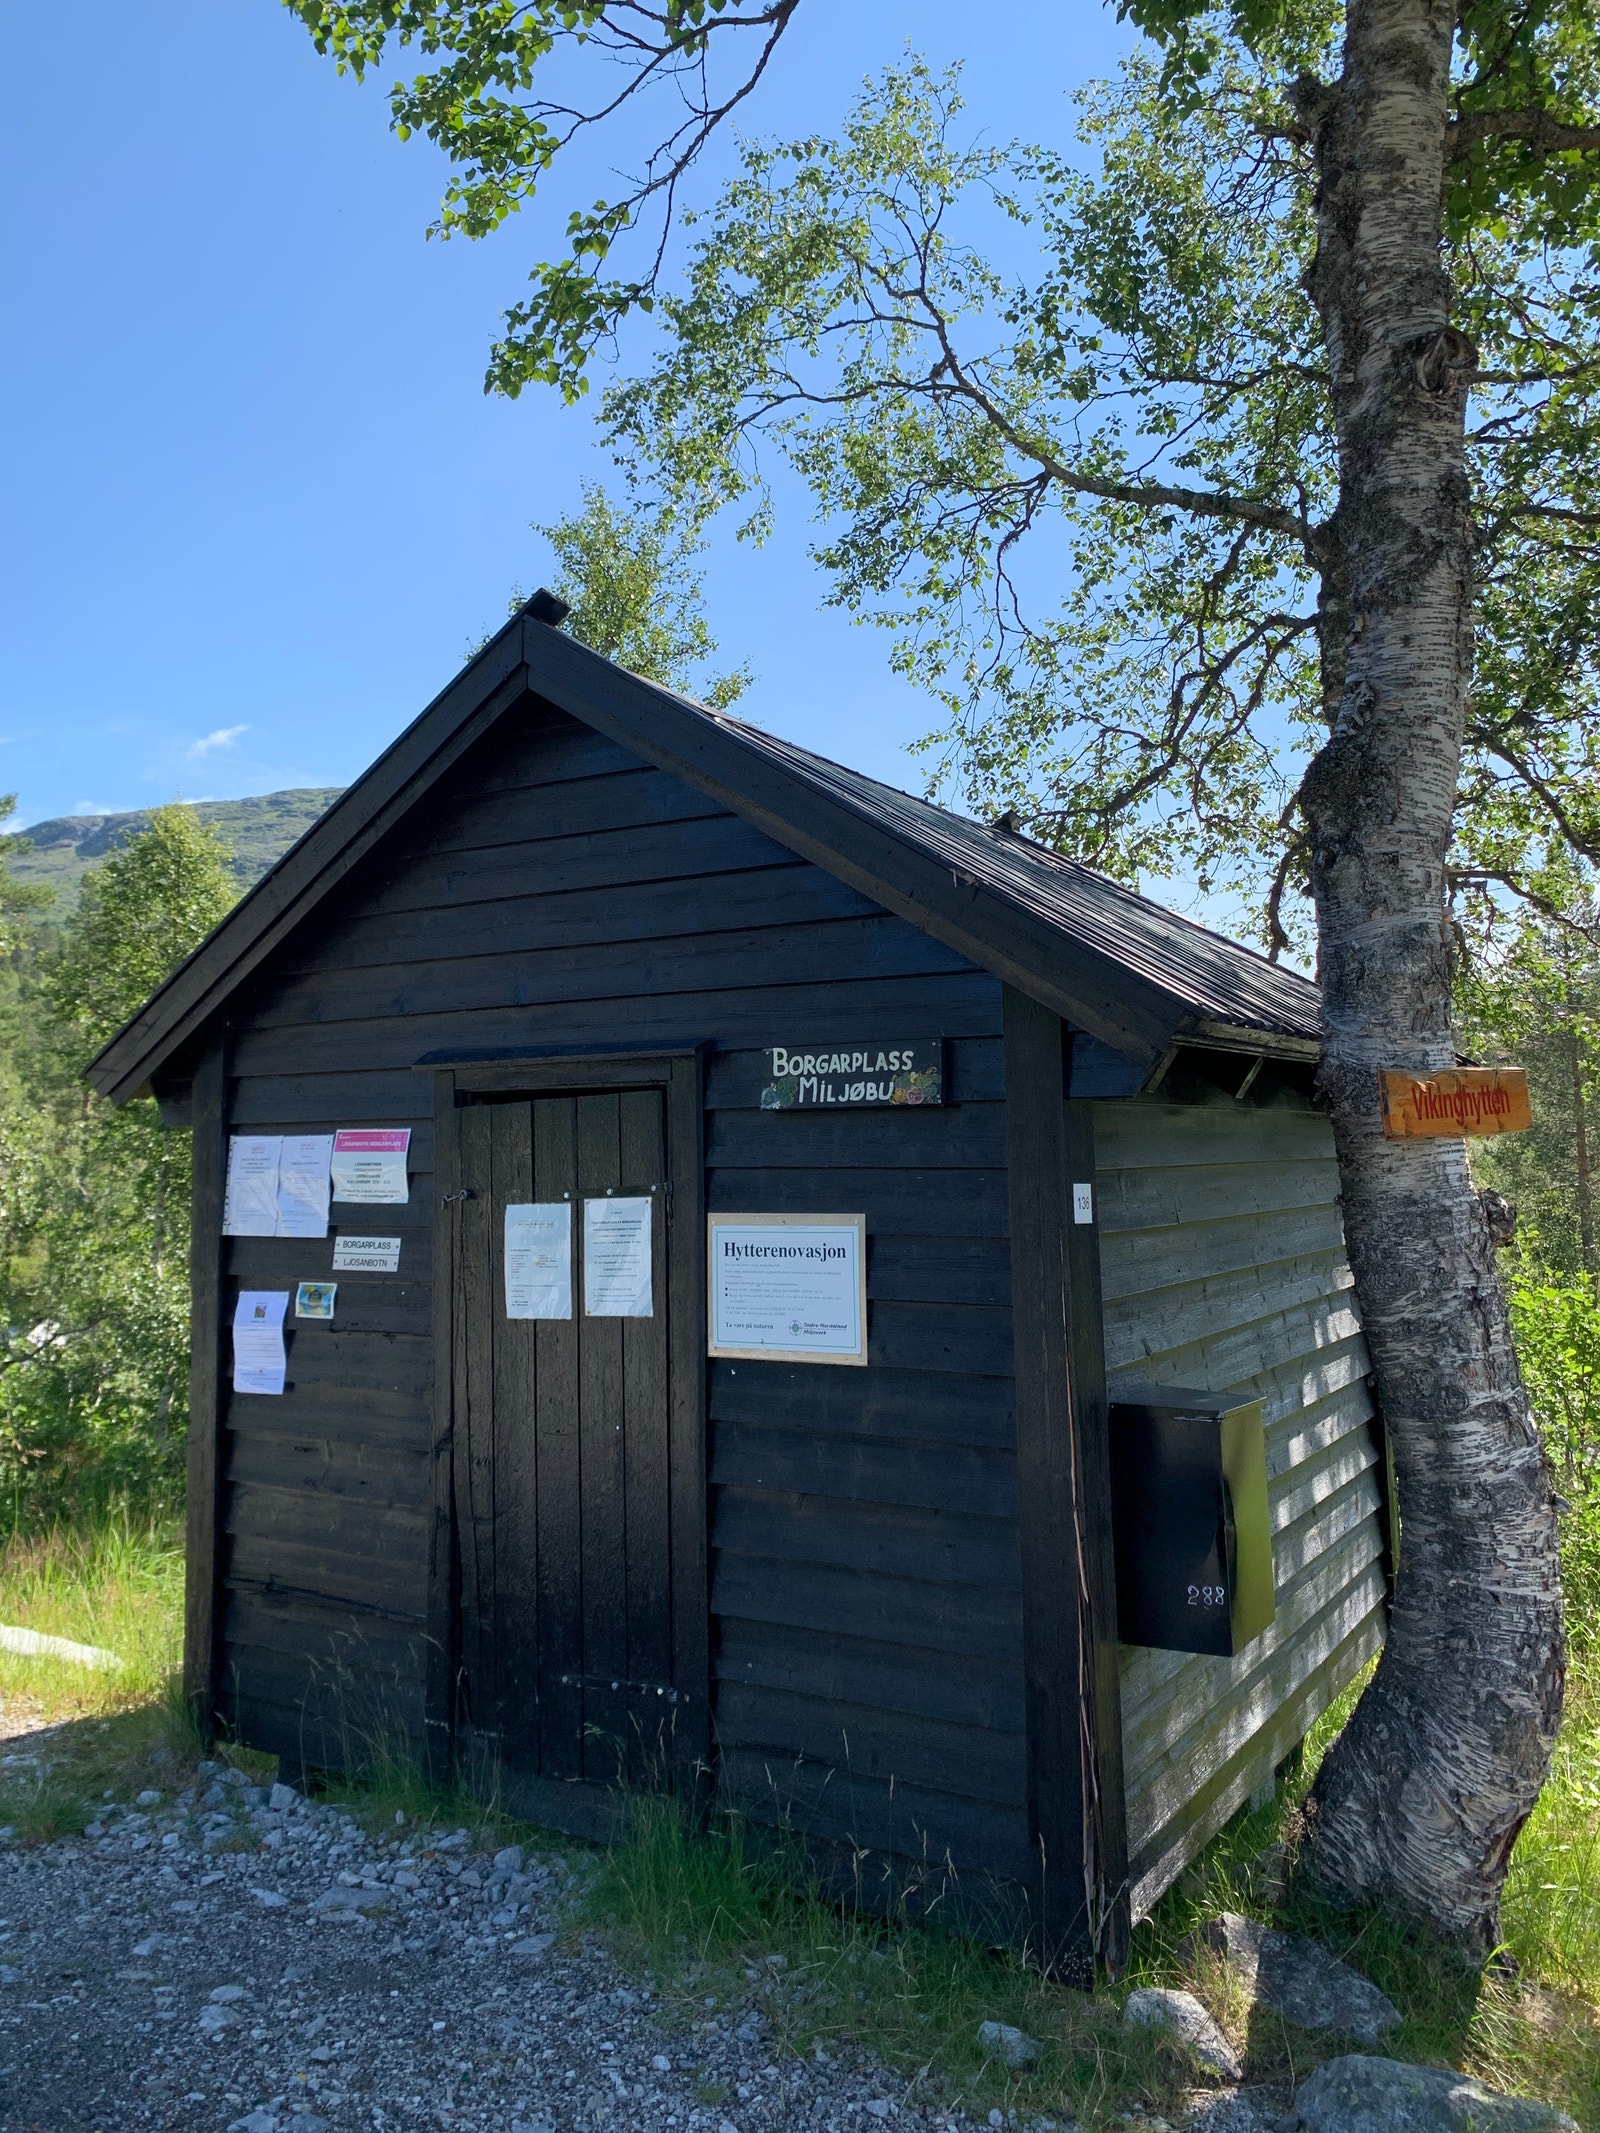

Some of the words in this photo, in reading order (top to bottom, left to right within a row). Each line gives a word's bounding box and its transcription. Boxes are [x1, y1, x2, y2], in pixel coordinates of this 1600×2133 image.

[772, 1047, 914, 1077] BORGARPLASS
[1411, 1084, 1510, 1127] Vikinghytten
[1077, 1196, 1090, 1210] 136
[342, 1240, 392, 1250] BORGARPLASS
[723, 1241, 846, 1262] Hytterenovasjon
[343, 1258, 388, 1268] LJOSANBOTN
[1187, 1584, 1225, 1606] 288
